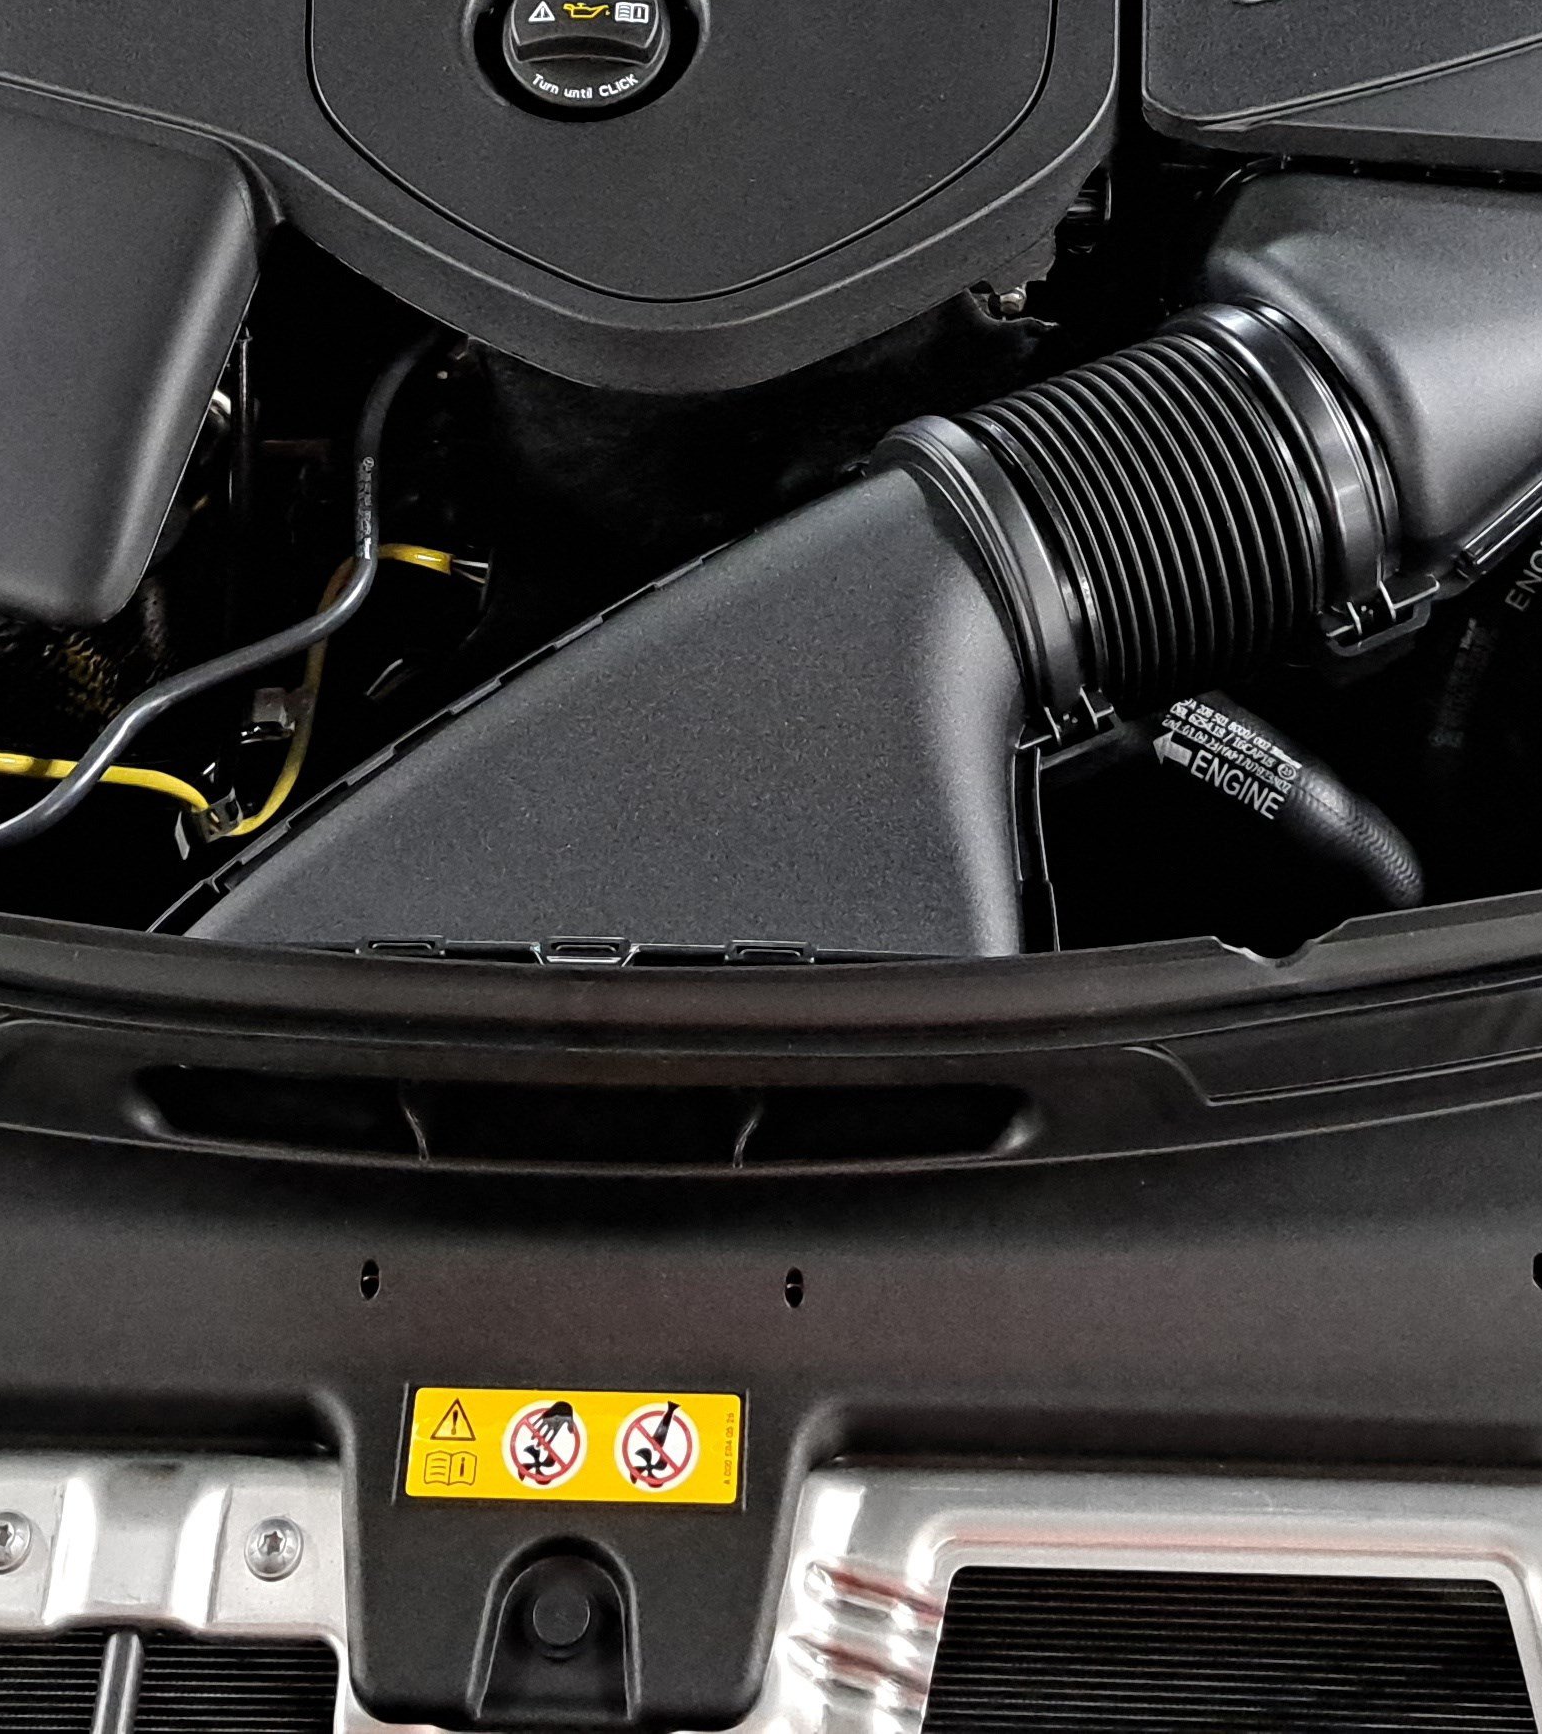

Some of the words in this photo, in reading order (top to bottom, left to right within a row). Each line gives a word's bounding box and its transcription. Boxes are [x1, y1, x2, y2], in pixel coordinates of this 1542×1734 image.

[532, 73, 559, 95] Turn
[563, 87, 593, 99] until
[599, 73, 639, 97] CLICK
[1190, 749, 1285, 820] ENGINE
